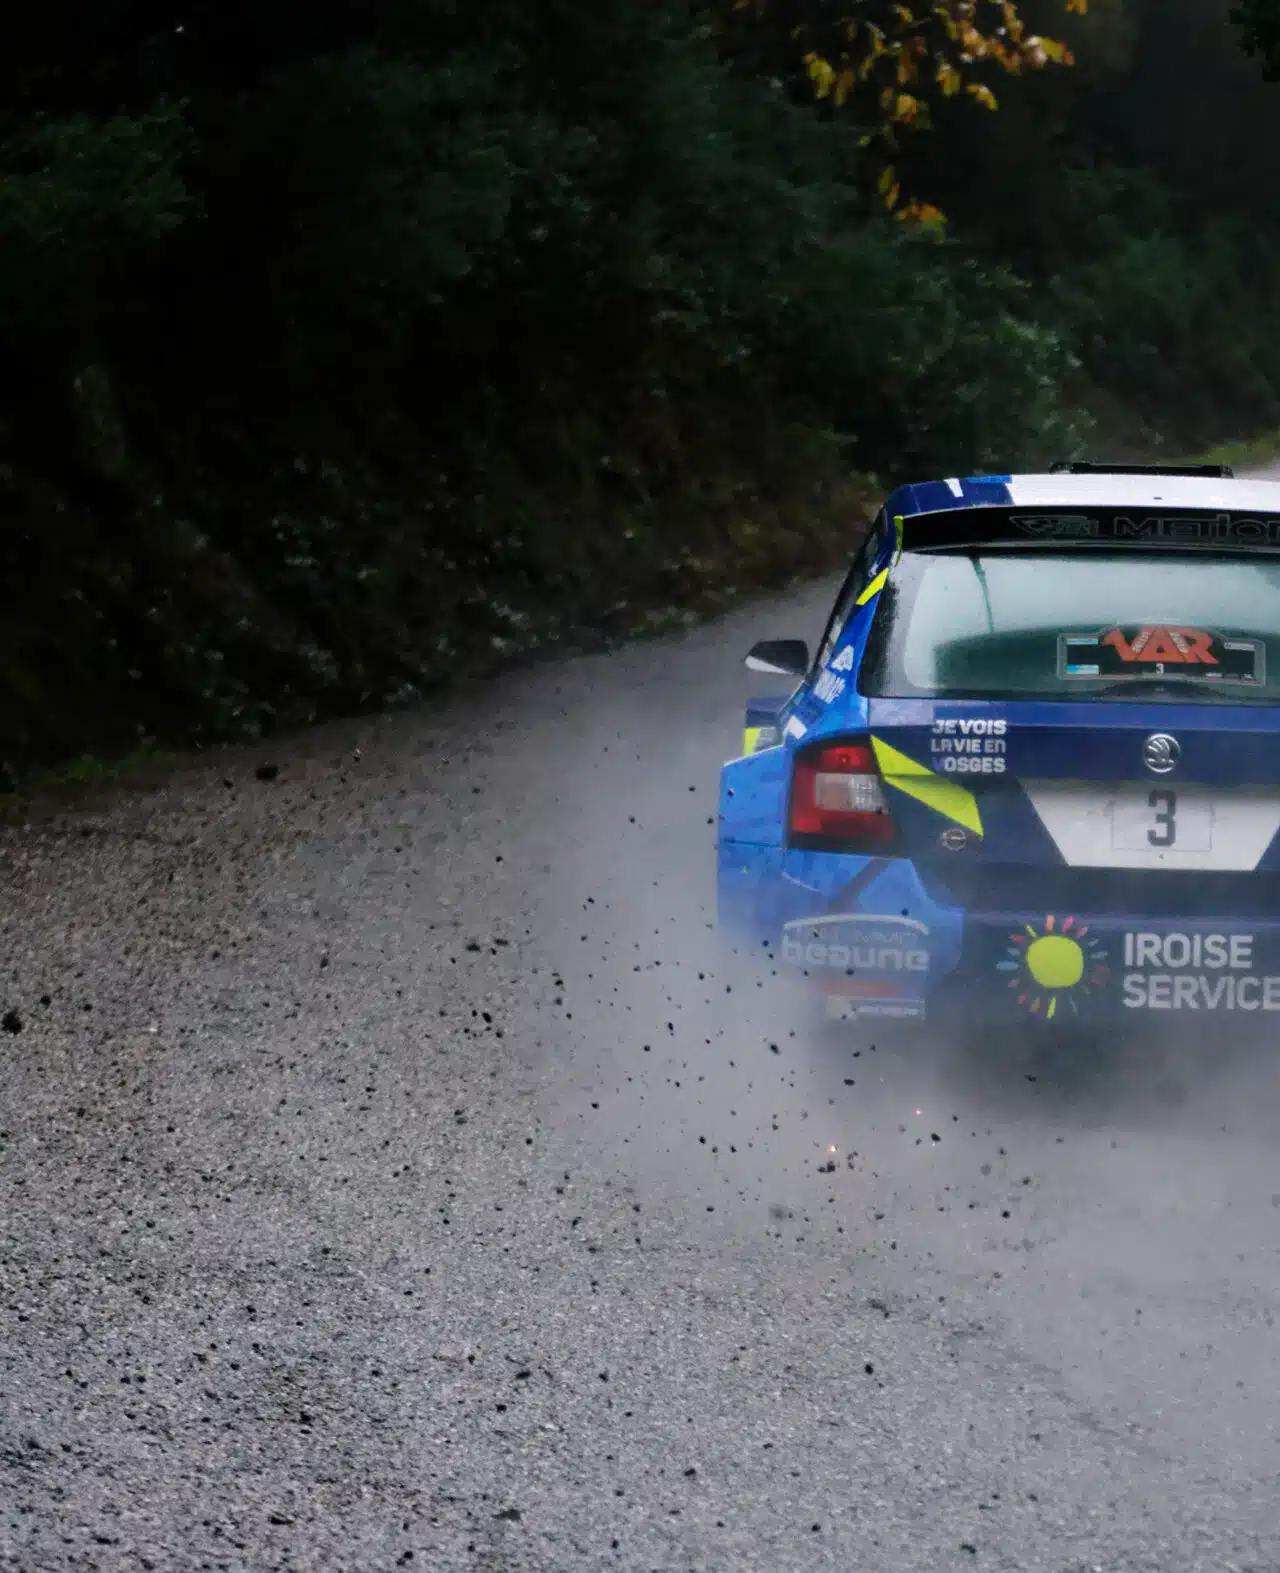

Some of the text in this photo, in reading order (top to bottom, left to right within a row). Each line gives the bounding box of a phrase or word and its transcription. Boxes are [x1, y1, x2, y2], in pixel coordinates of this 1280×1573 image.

[1103, 624, 1220, 664] VAR
[1155, 662, 1165, 675] 3
[932, 719, 1008, 735] JE VOIS
[931, 738, 952, 752] LA
[953, 738, 982, 753] VIE
[932, 756, 1007, 773] VOSGES
[1147, 789, 1176, 847] 3
[781, 934, 931, 972] beaune
[1124, 932, 1254, 969] IROISE
